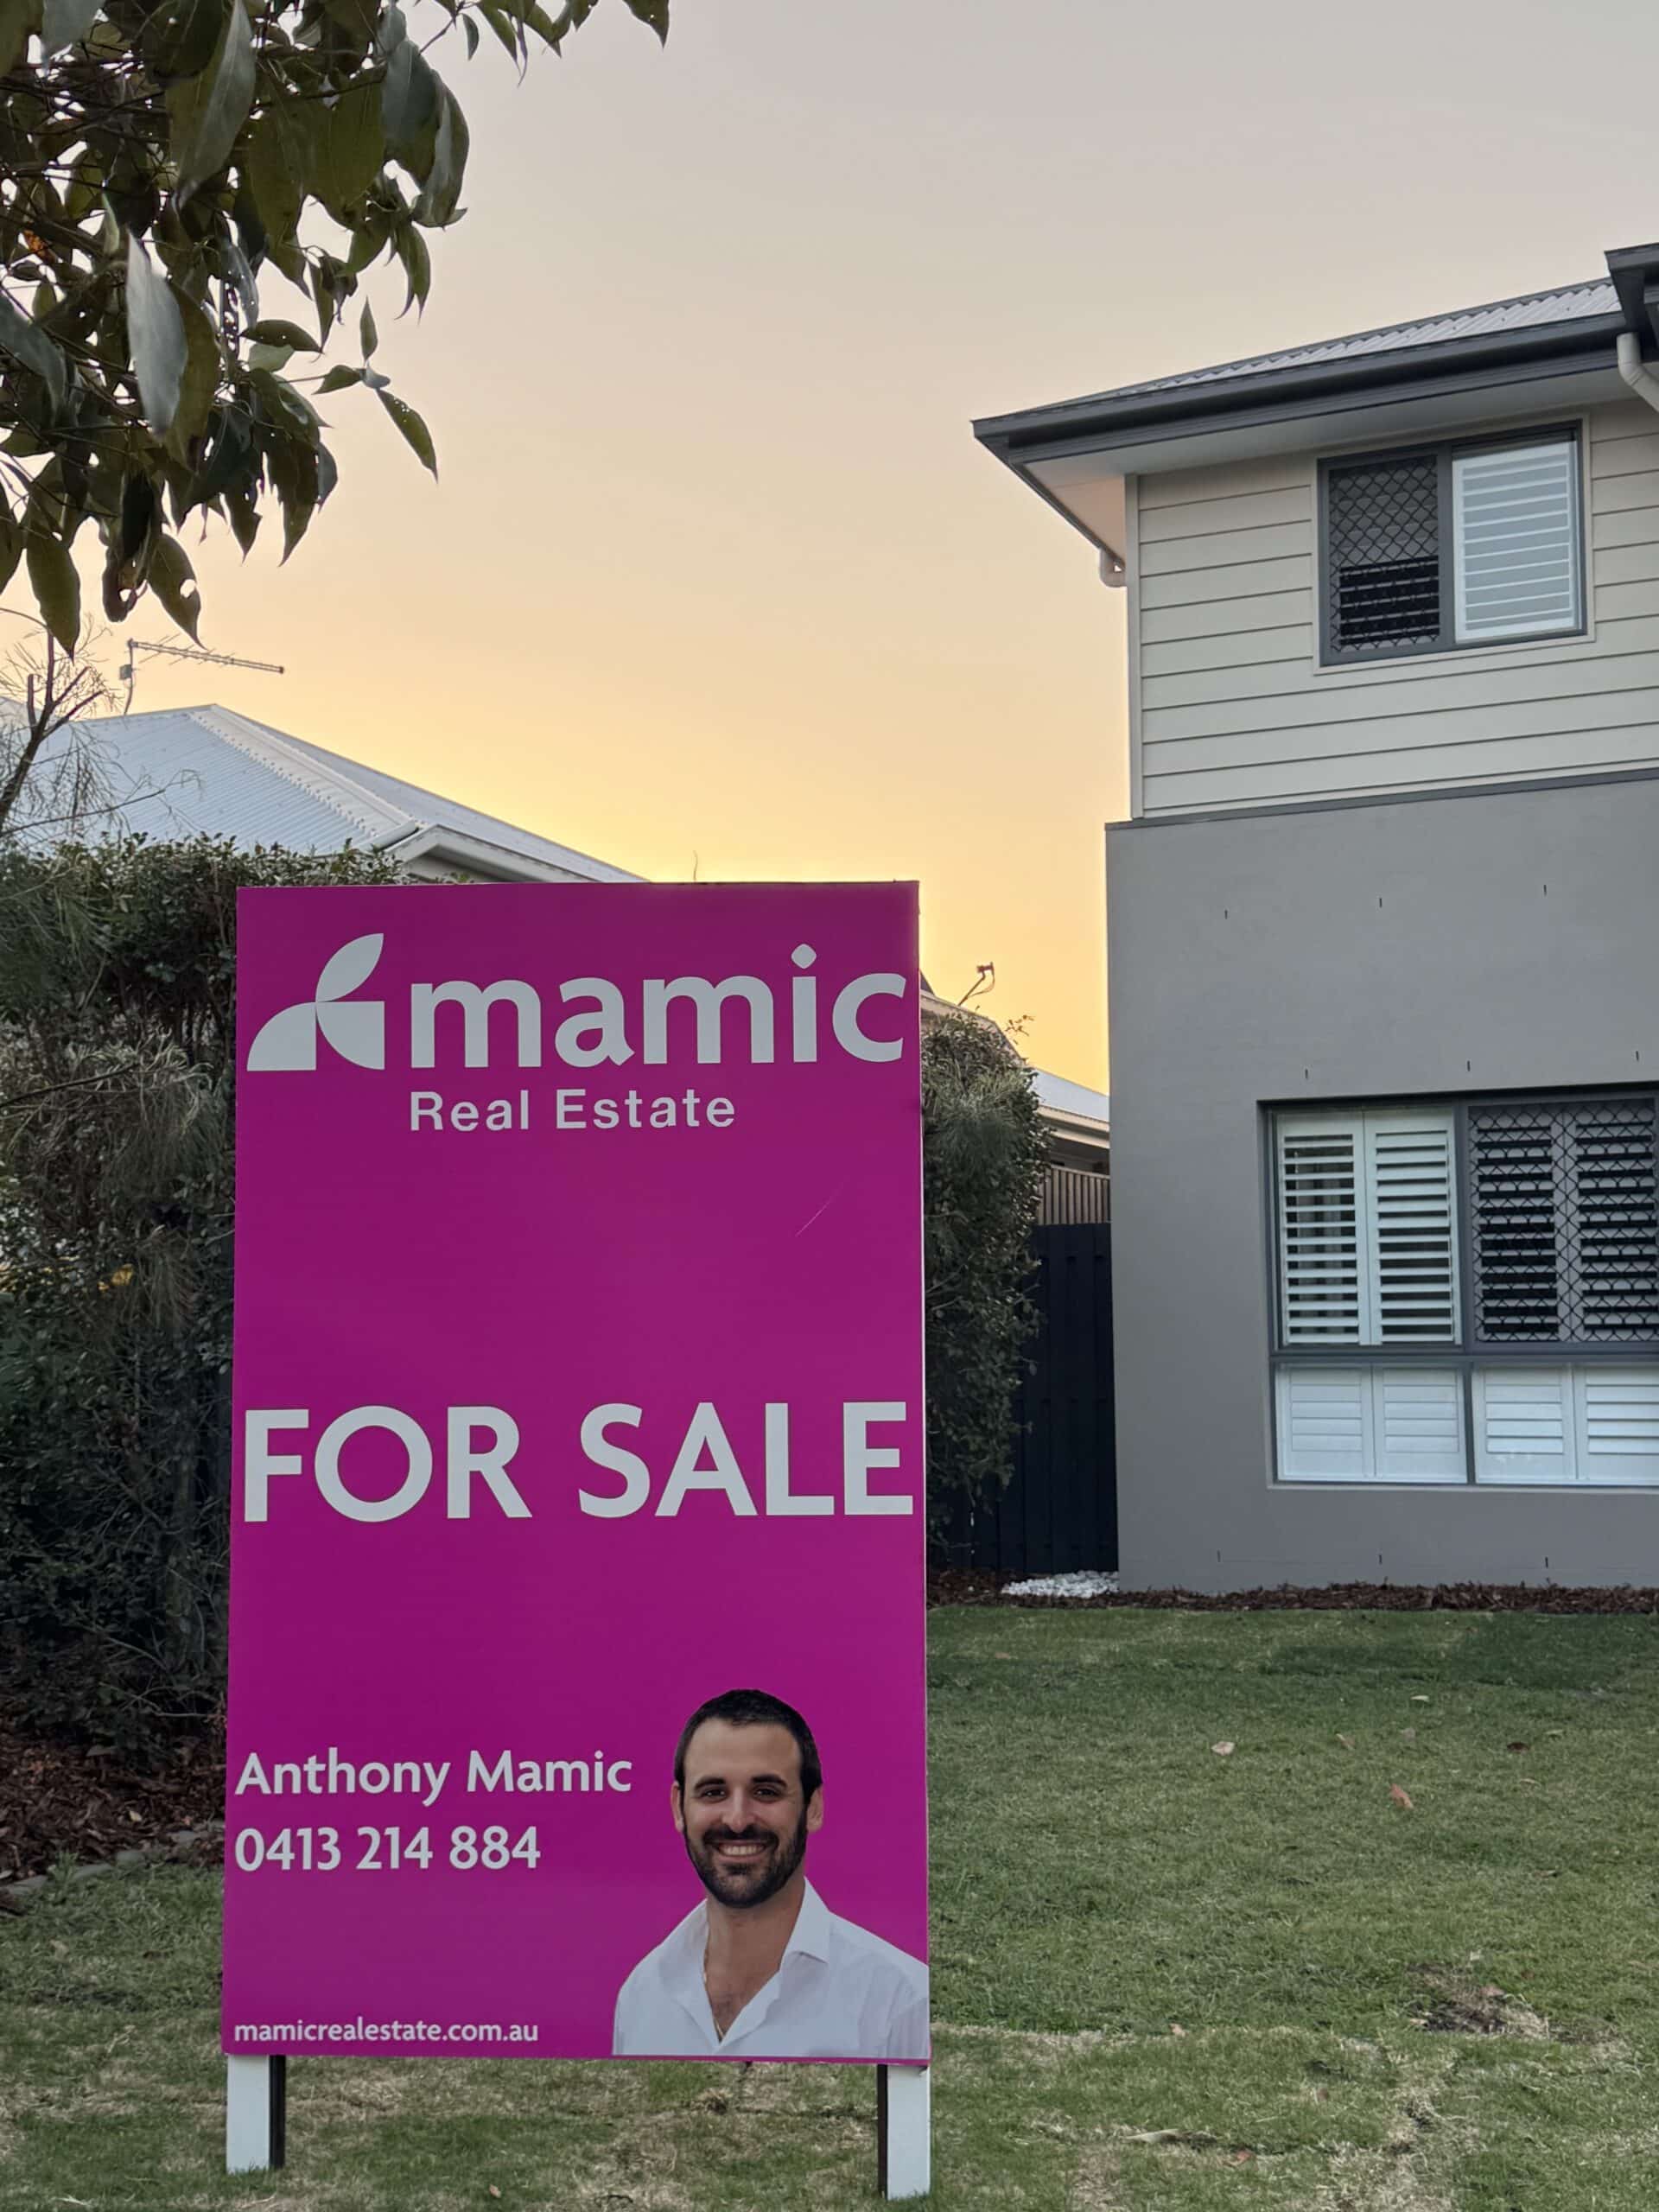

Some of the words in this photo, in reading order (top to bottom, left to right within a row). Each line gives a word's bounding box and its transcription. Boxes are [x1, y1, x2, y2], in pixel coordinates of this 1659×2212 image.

[410, 943, 907, 1070] mamic
[410, 1089, 530, 1132] Real
[556, 1088, 735, 1130] Estate
[243, 1404, 534, 1524] FOR
[577, 1400, 916, 1519] SALE
[234, 1746, 451, 1807] Anthony
[467, 1749, 632, 1793] Mamic
[234, 1826, 342, 1872] 0413
[355, 1825, 434, 1871] 214
[448, 1824, 542, 1871] 884
[233, 2016, 539, 2043] mamicrealestate.com.au
